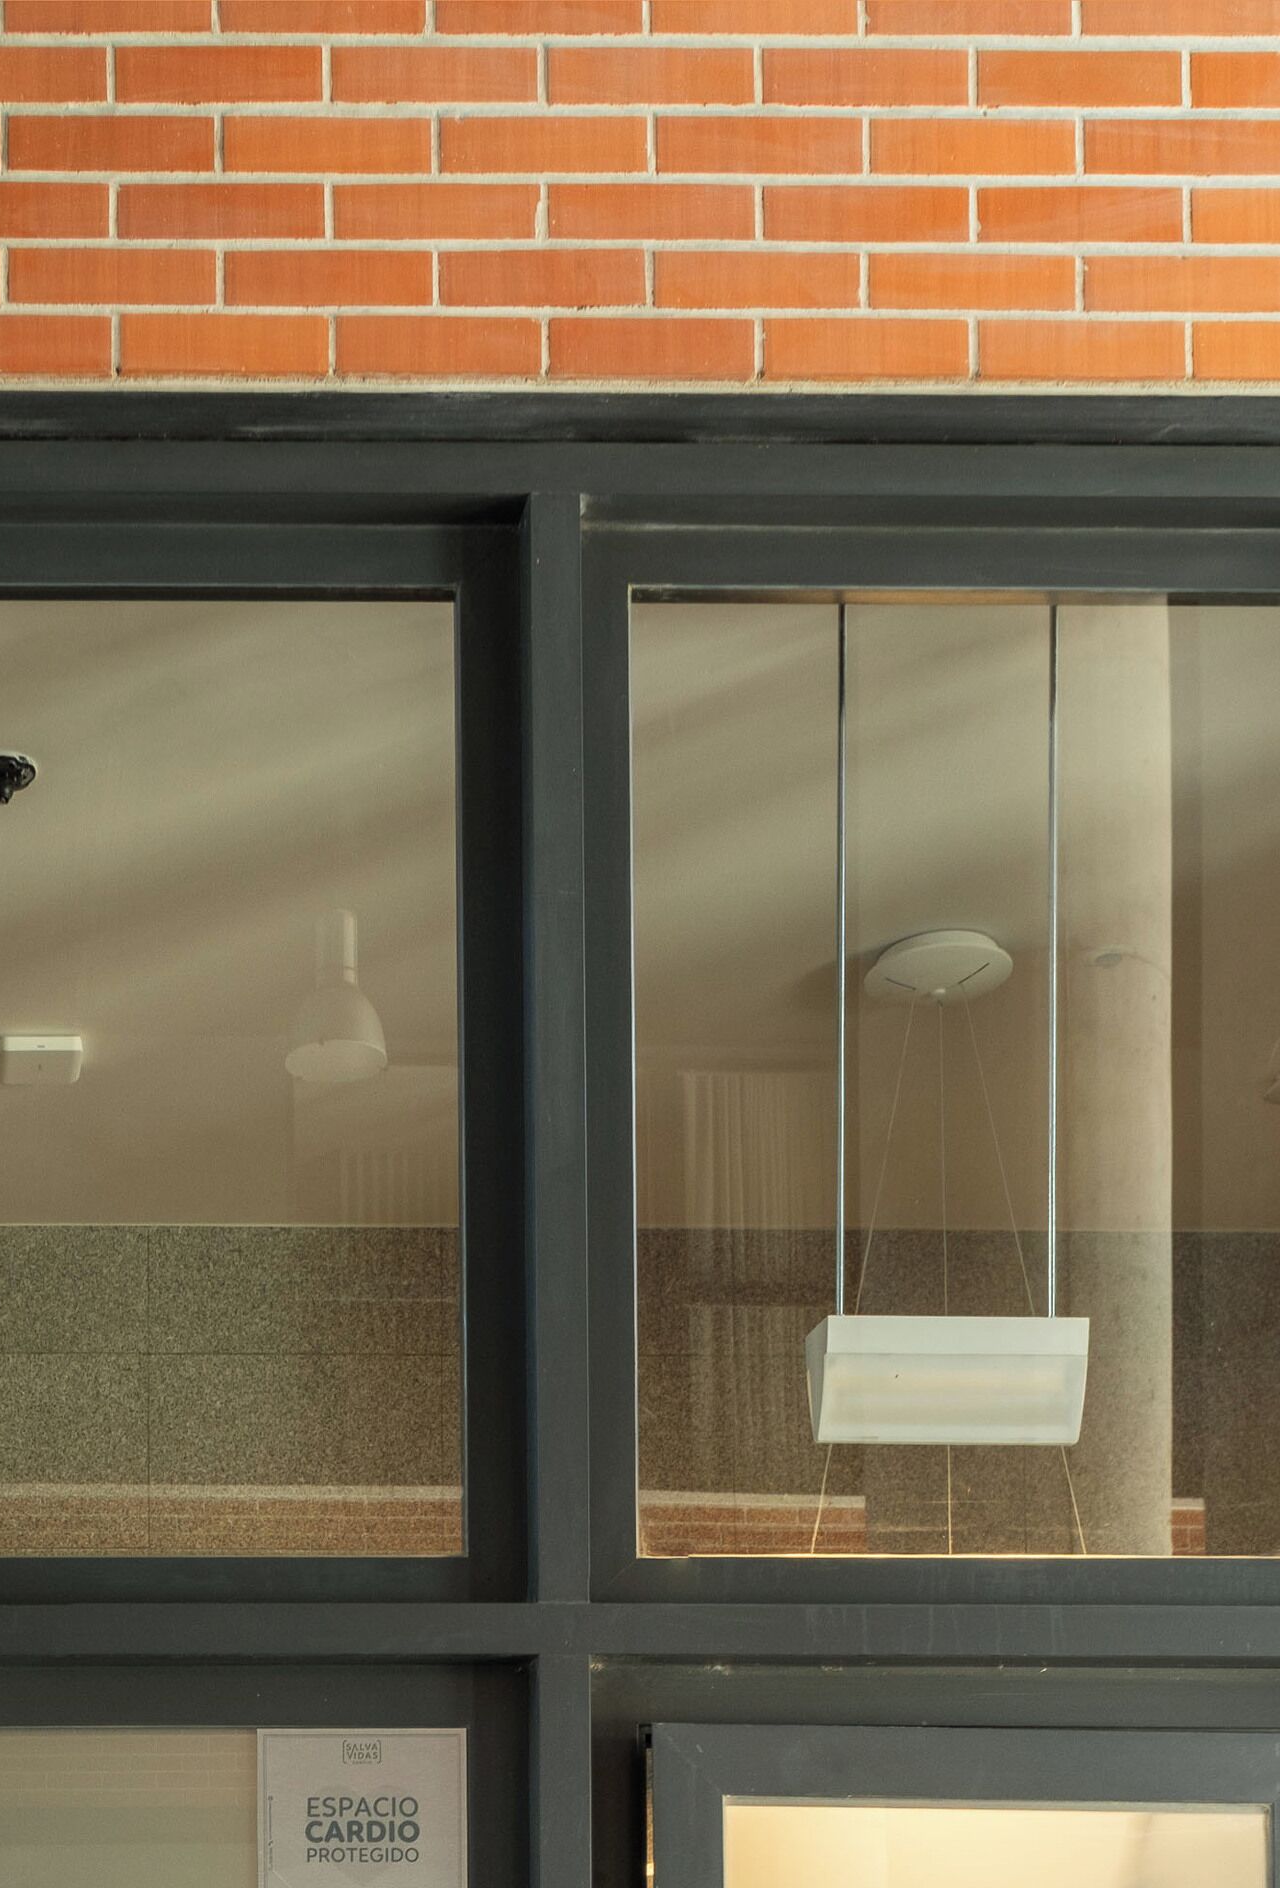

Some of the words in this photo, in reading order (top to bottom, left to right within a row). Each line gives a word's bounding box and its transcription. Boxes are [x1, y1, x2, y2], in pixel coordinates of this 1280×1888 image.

[345, 1743, 379, 1752] SALVA
[346, 1751, 379, 1760] VIDAS
[306, 1796, 419, 1818] ESPACIO
[304, 1820, 420, 1843] CARDIO
[306, 1847, 419, 1863] PROTEGIDO
